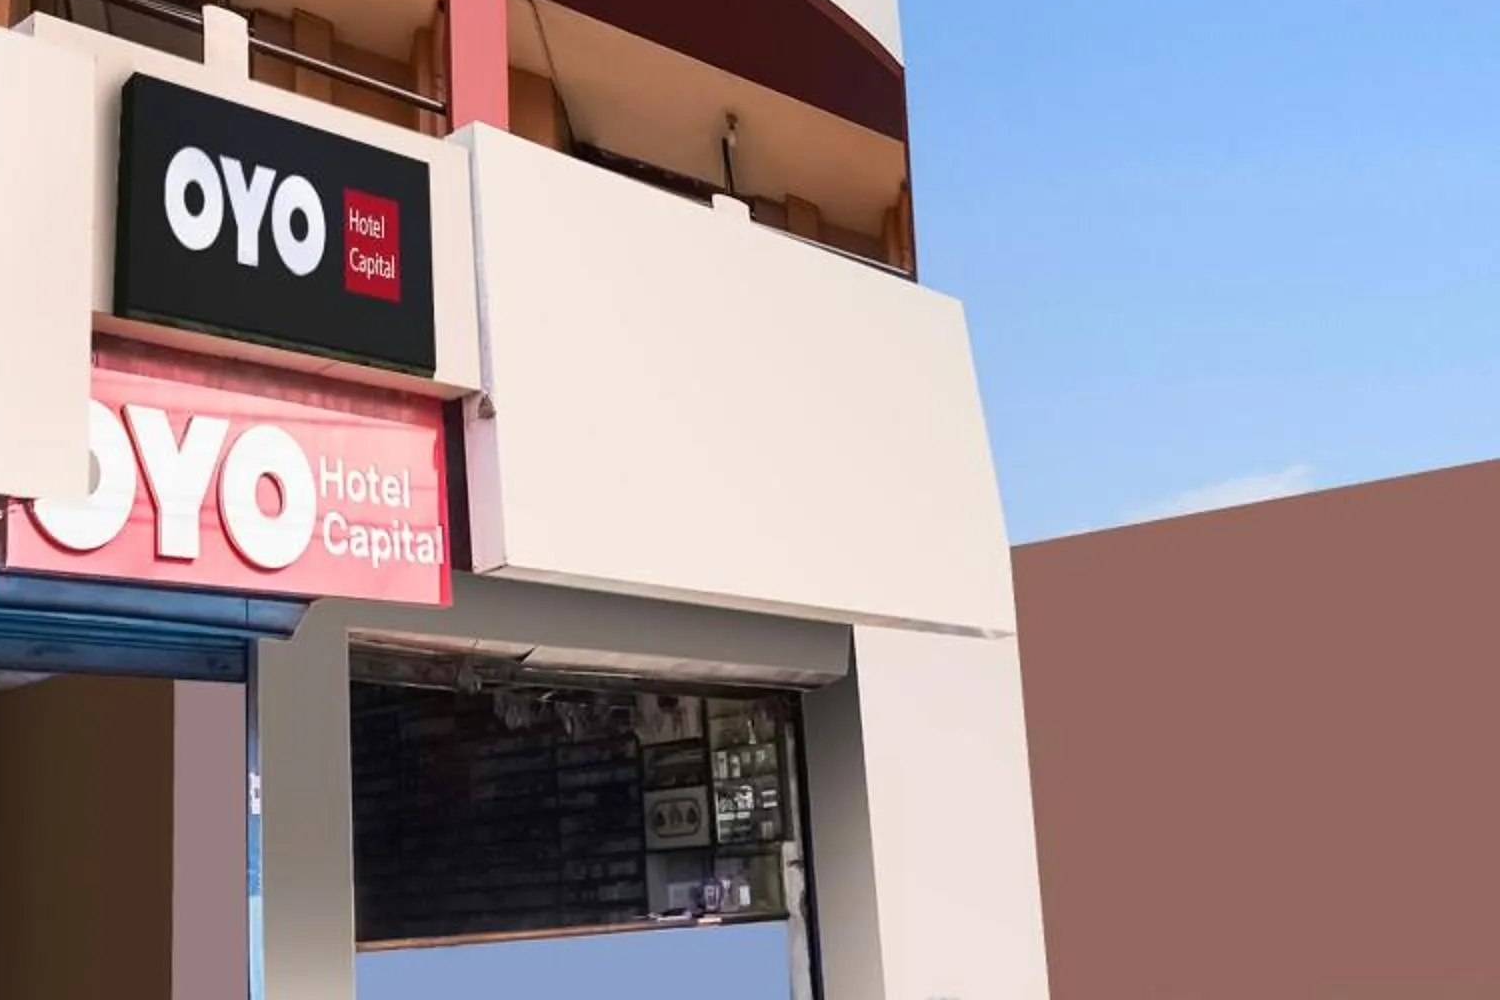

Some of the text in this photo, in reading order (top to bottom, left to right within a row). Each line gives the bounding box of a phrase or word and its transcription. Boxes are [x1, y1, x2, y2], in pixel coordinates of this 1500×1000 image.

[164, 145, 326, 276] OYO
[348, 207, 385, 239] Hotel
[349, 247, 395, 280] Capital
[319, 455, 411, 509] Hotel
[323, 510, 444, 569] Capital
